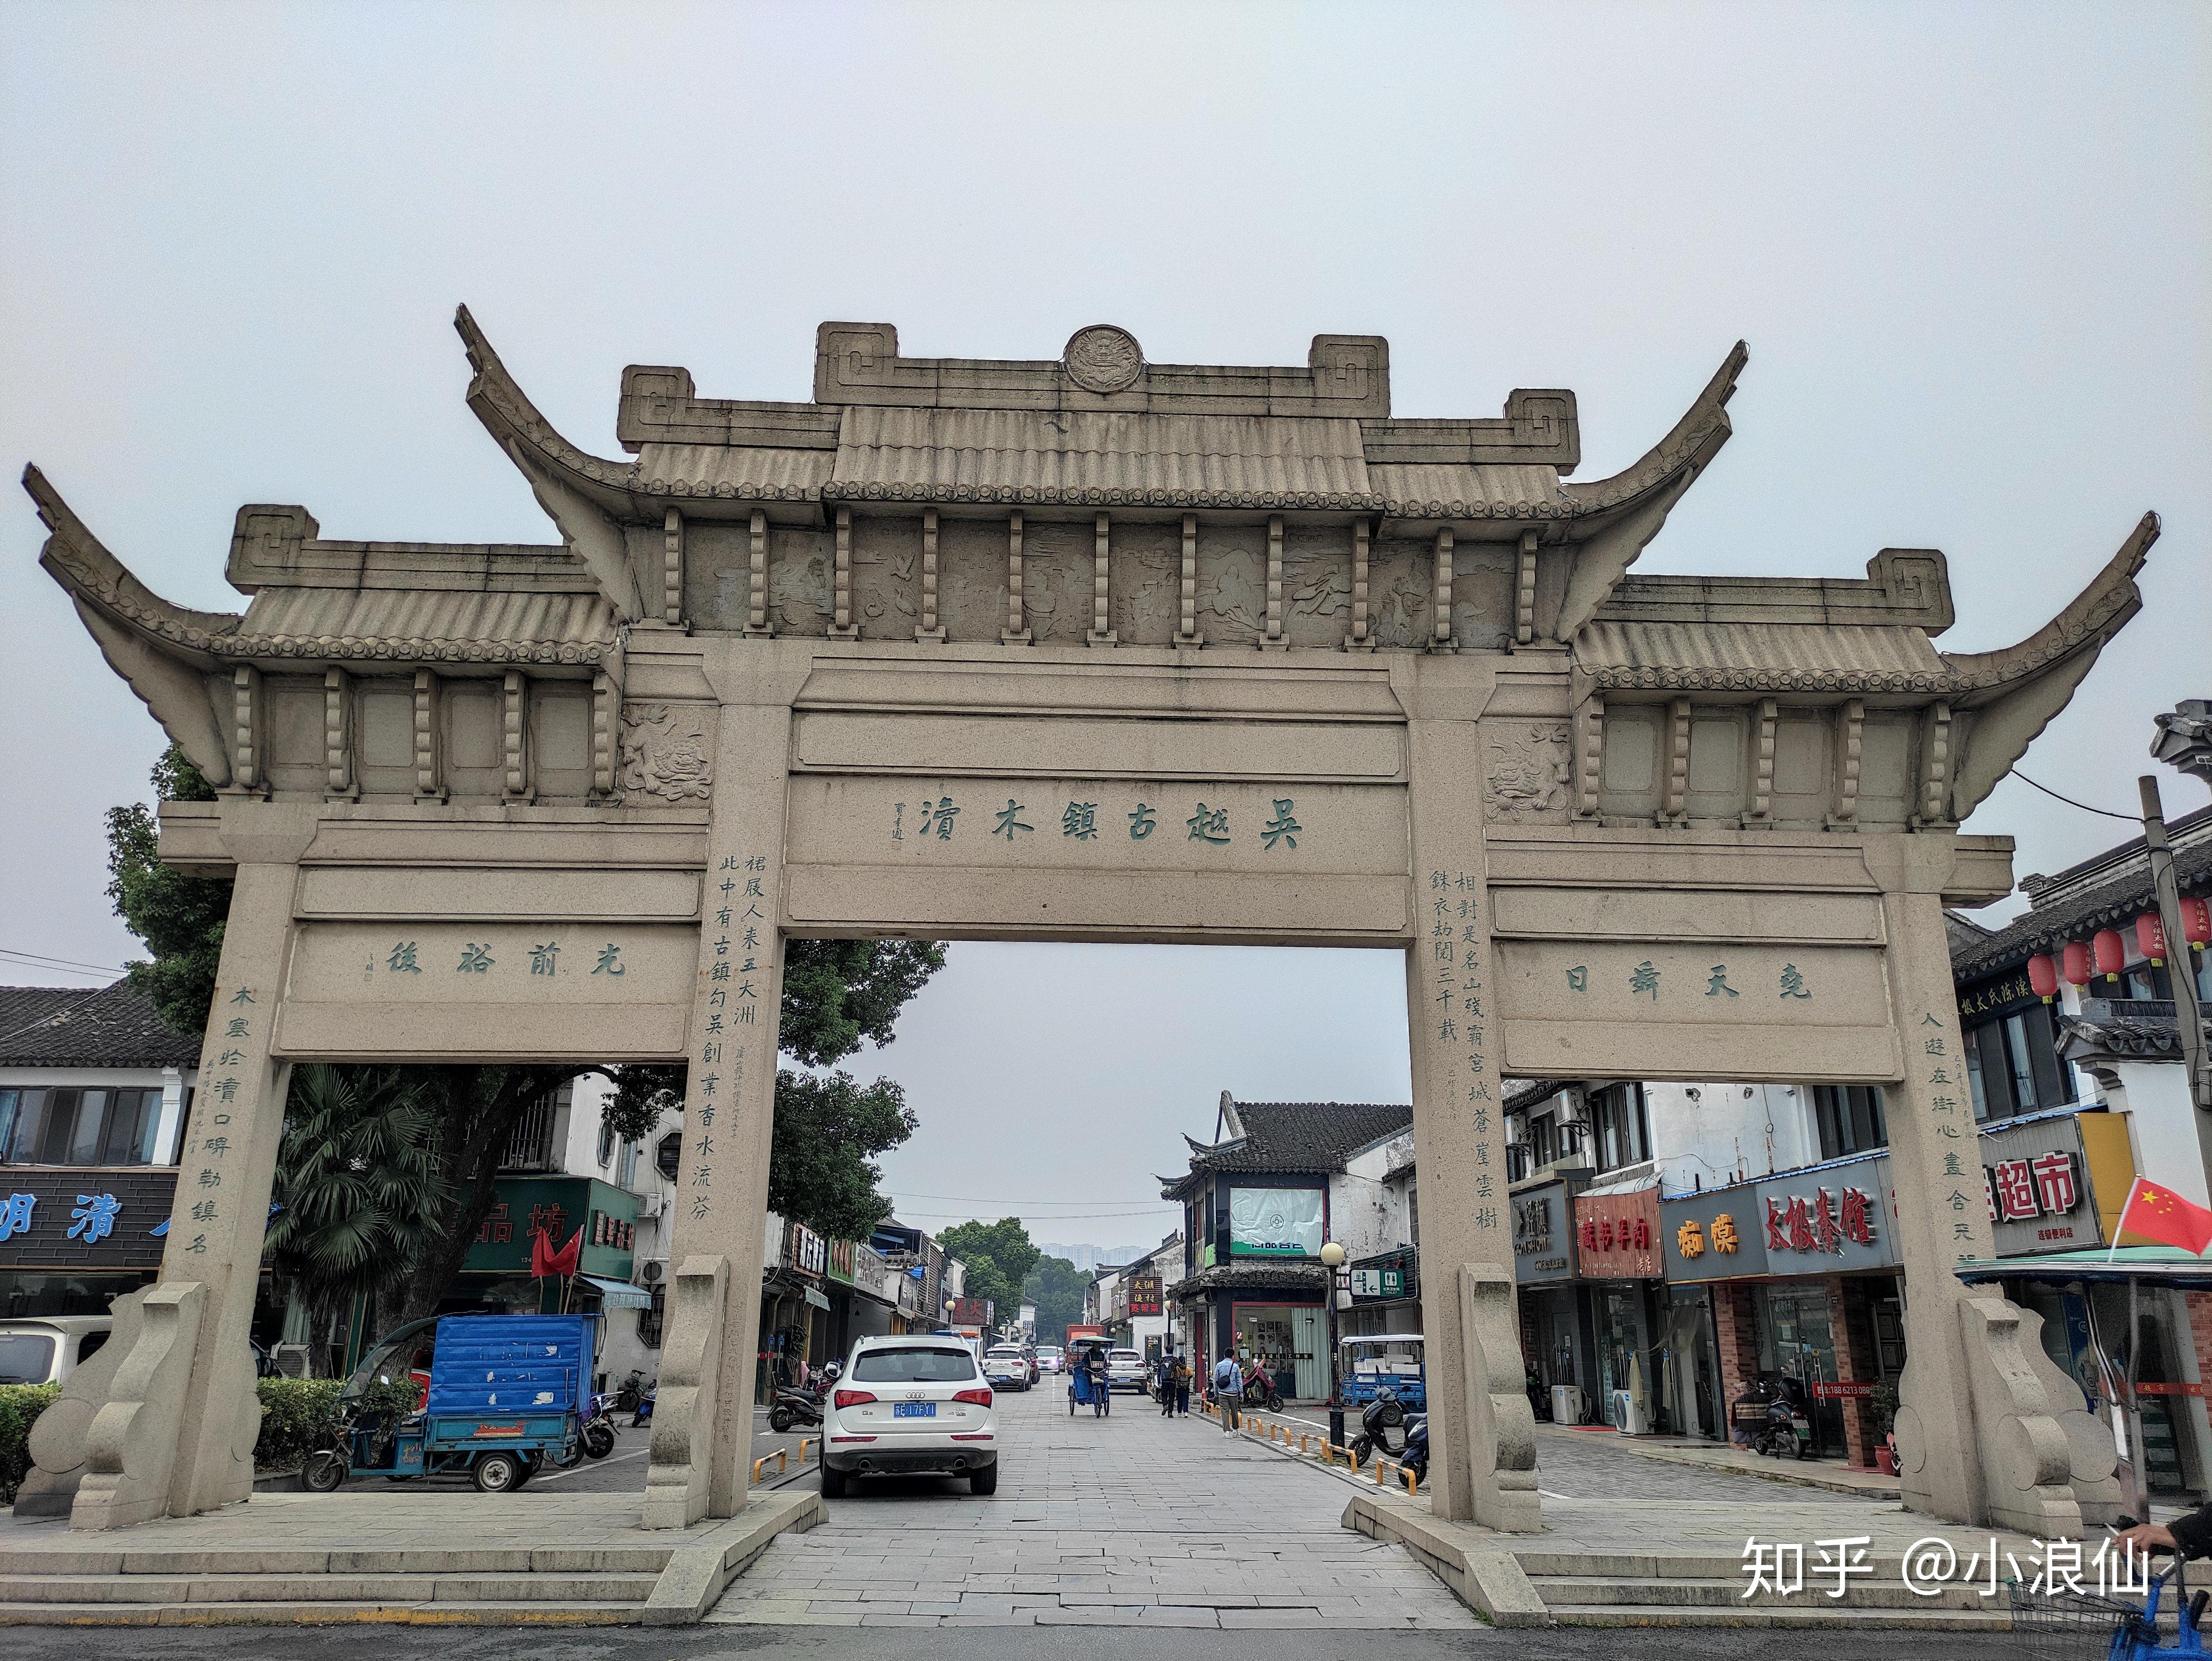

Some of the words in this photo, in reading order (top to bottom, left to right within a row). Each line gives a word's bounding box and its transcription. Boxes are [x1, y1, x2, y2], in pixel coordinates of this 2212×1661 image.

[2037, 1227, 2073, 1240] 连锁便利店
[1134, 1280, 1154, 1289] 太湖
